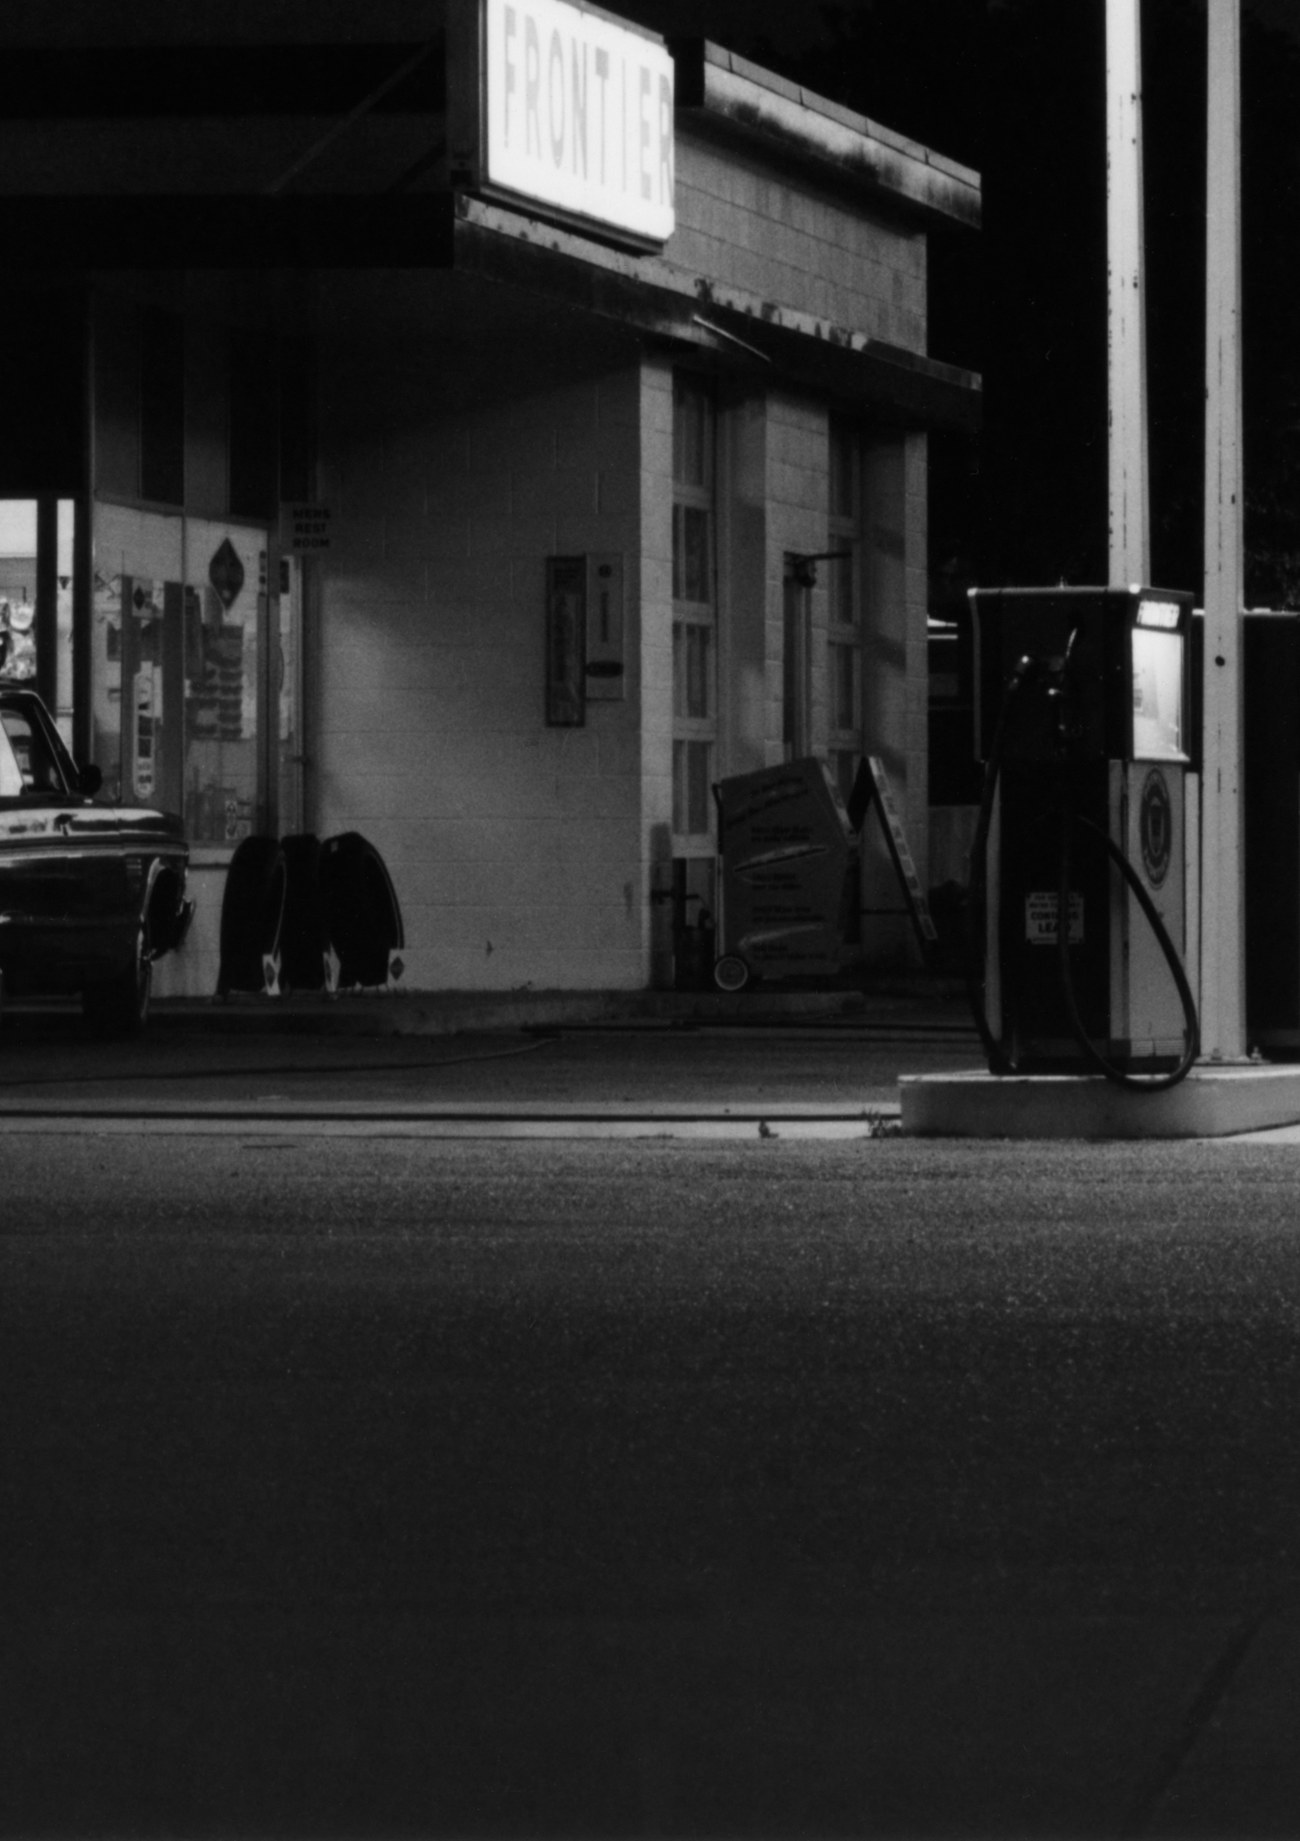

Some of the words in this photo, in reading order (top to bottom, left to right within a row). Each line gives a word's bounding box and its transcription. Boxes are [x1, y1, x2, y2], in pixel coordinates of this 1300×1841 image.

[504, 3, 672, 206] FRONTIER
[293, 508, 331, 519] MENS
[295, 523, 326, 533] REST
[293, 537, 330, 548] ROOM
